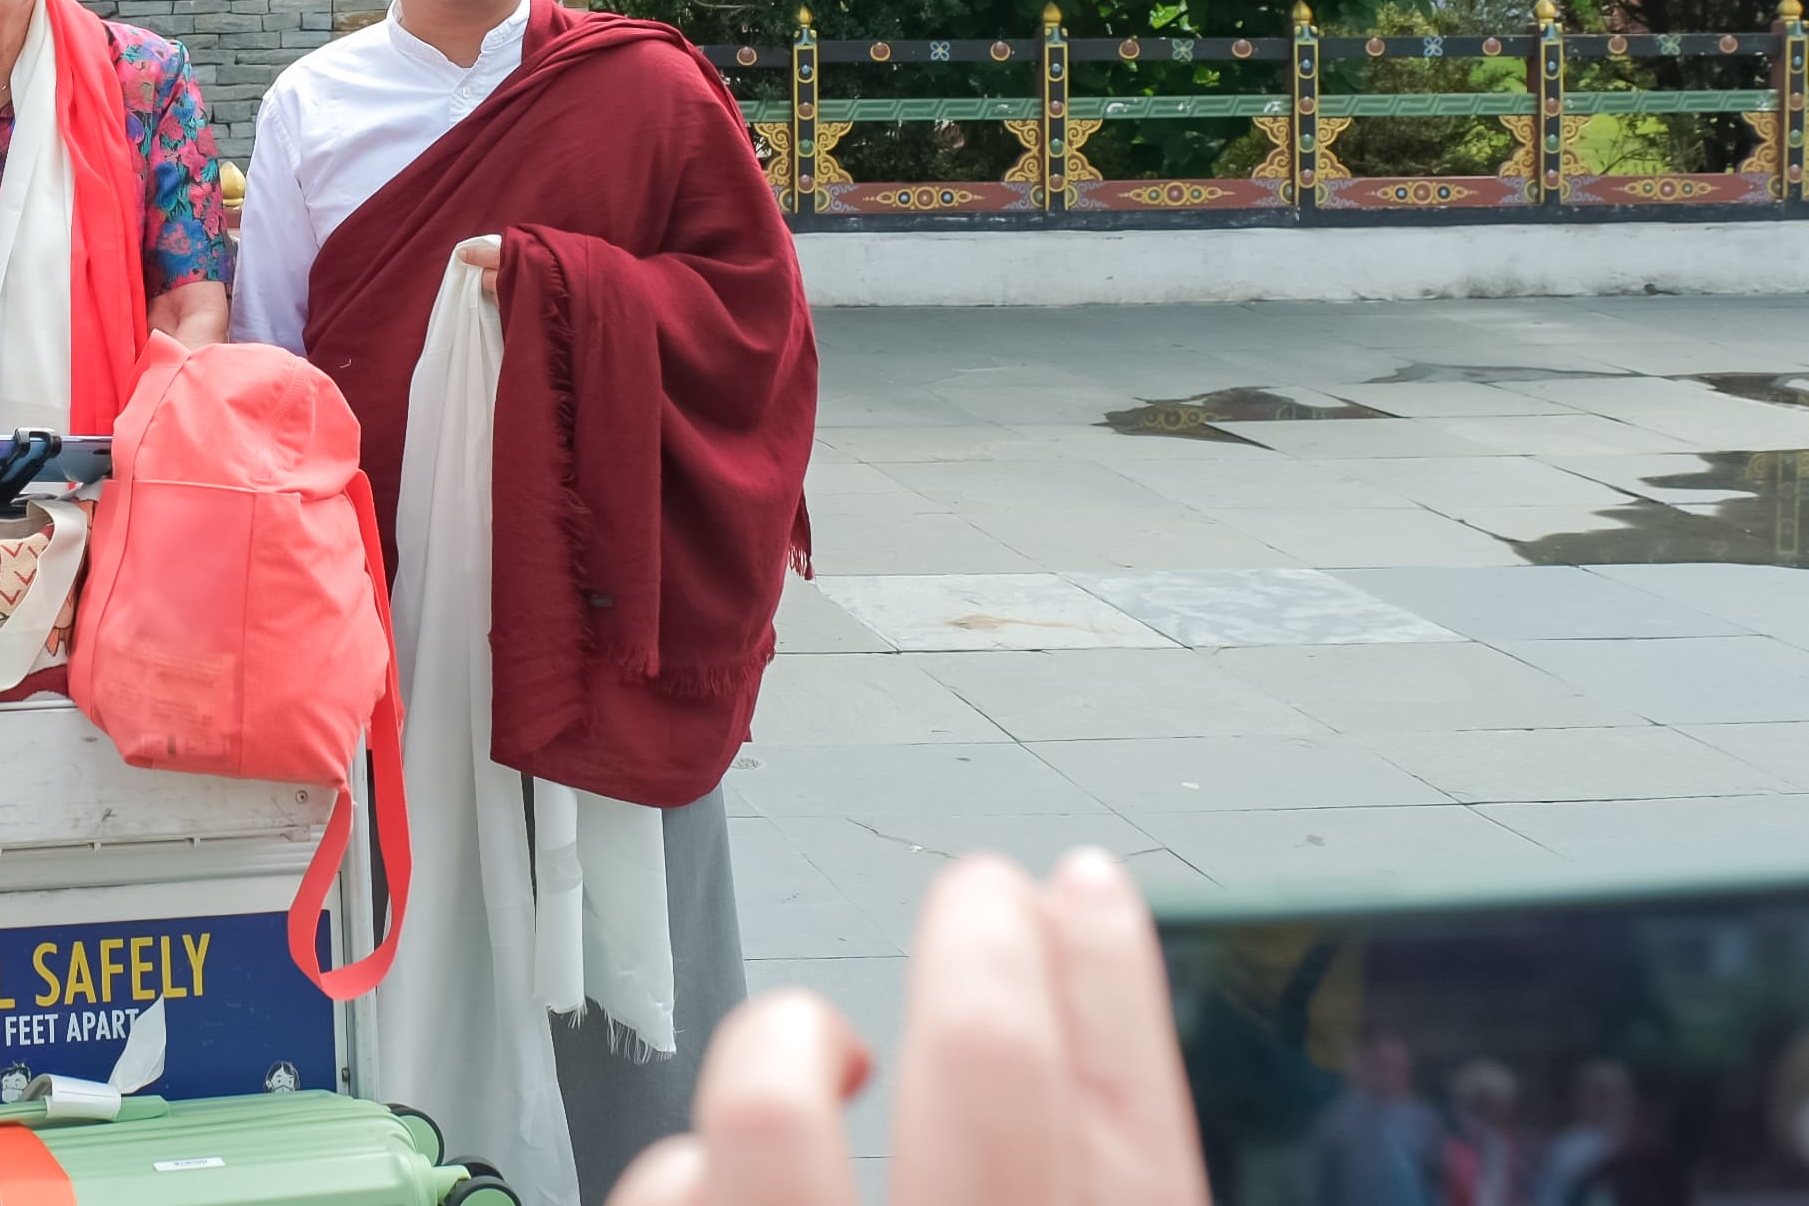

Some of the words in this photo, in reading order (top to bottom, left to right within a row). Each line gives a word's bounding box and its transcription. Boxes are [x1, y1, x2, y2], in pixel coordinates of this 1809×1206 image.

[31, 932, 211, 1007] SAFELY
[5, 1013, 59, 1047] FEET
[66, 1007, 140, 1043] APART
